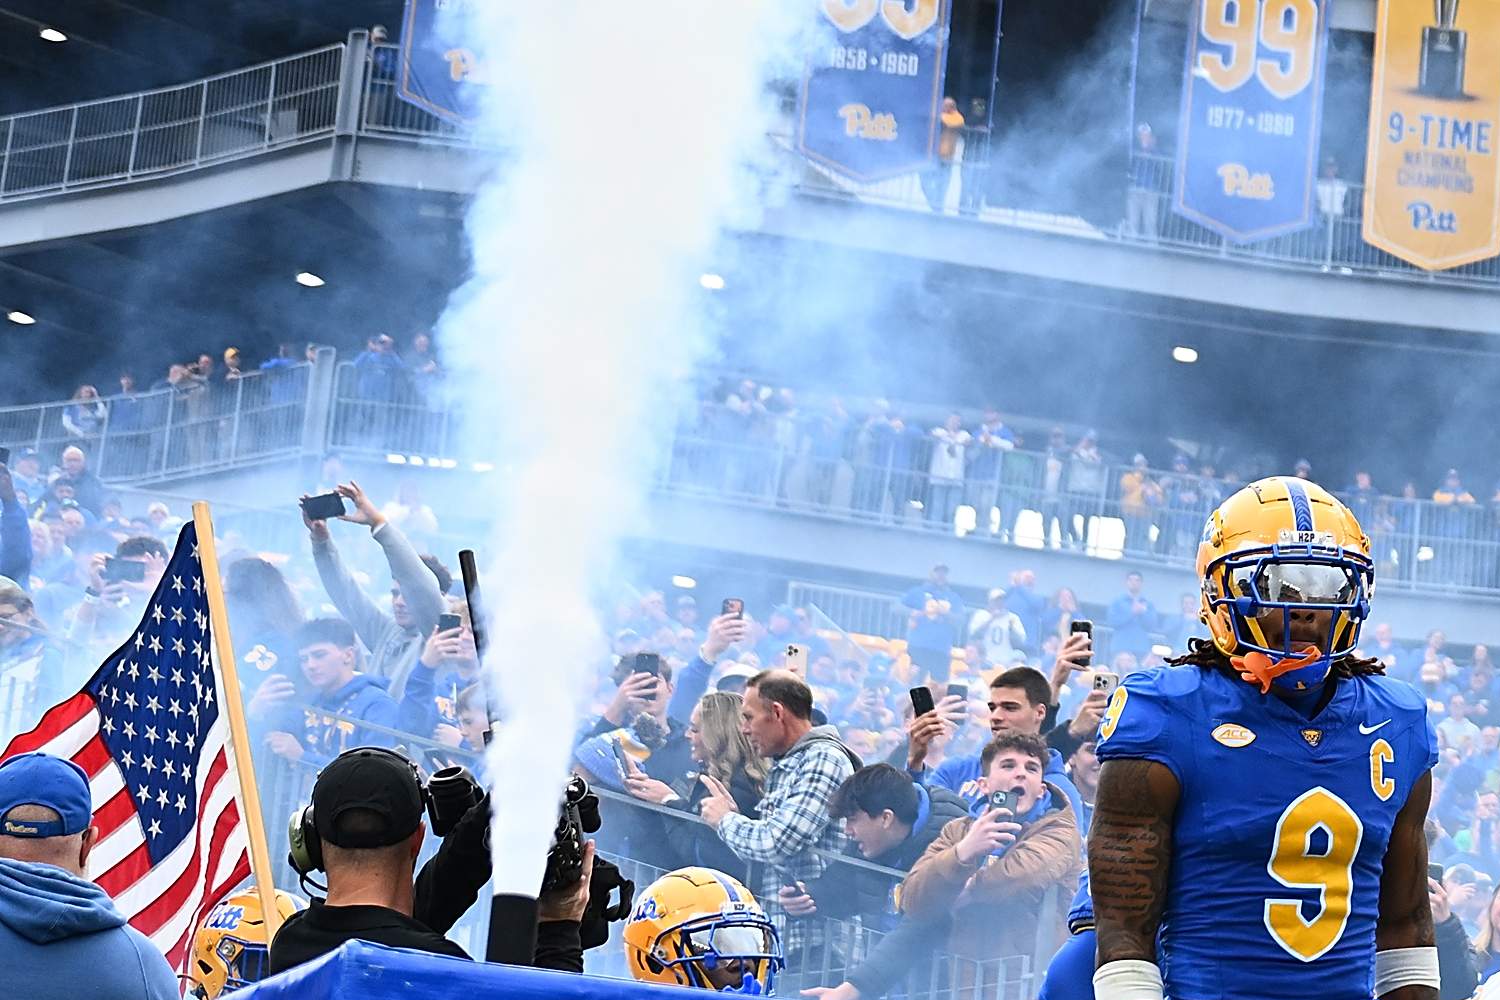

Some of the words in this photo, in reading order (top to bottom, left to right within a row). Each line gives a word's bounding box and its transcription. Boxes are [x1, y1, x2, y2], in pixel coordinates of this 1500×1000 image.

[881, 52, 919, 76] 1960
[1199, 0, 1318, 100] 99
[838, 104, 898, 141] Pitt
[1208, 107, 1244, 129] 1977
[1388, 110, 1492, 155] 9-TIME
[1217, 163, 1275, 200] Pitt
[1407, 202, 1457, 233] Pitt
[1298, 533, 1315, 542] H2P
[1100, 685, 1129, 741] 9
[1219, 728, 1248, 740] ACC
[1369, 738, 1395, 802] C
[1264, 786, 1363, 962] 9
